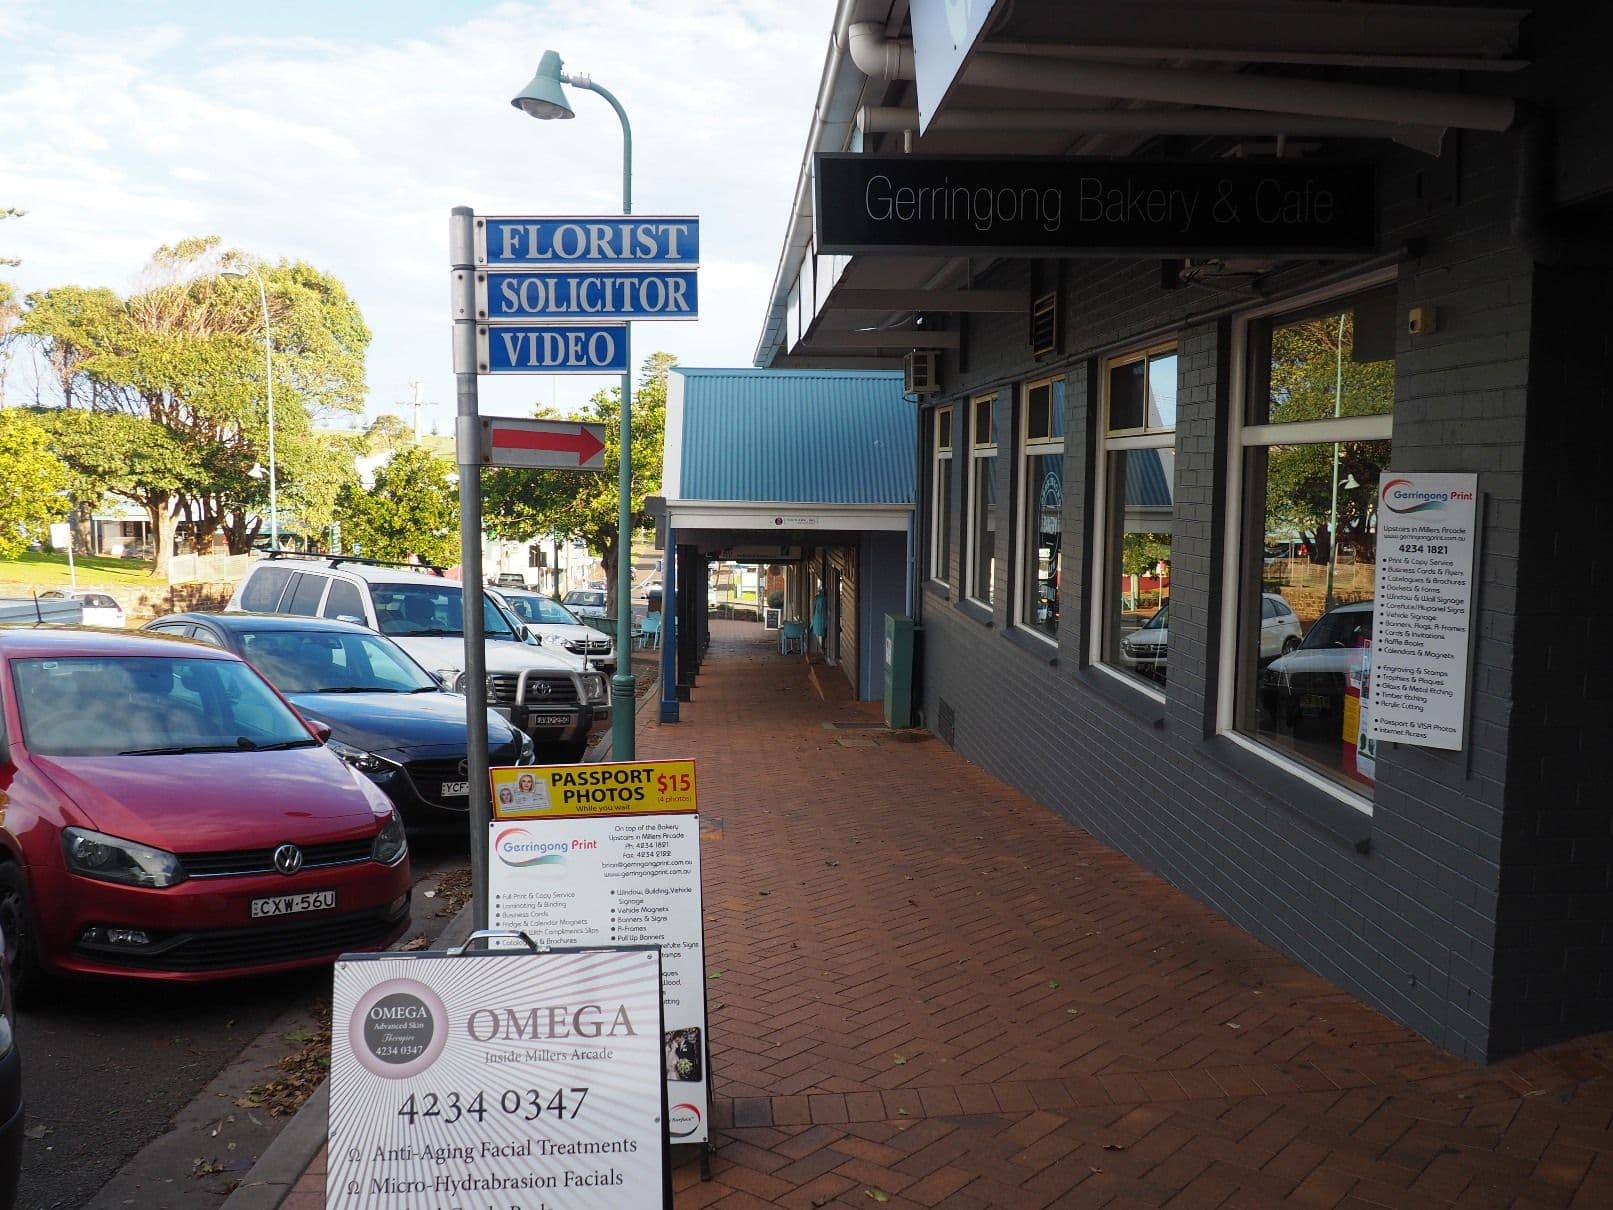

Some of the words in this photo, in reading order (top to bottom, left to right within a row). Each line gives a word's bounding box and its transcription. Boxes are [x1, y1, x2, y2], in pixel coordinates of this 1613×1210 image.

[865, 175, 1062, 231] Gerringong
[1080, 177, 1199, 232] Bakery
[1212, 178, 1240, 223] &
[1255, 178, 1335, 224] Cafe
[499, 224, 688, 259] FLORIST
[501, 277, 690, 313] SOLICITOR
[501, 331, 615, 367] VIDEO
[1394, 491, 1447, 501] Gerringong
[1451, 492, 1472, 500] Print
[1399, 545, 1423, 553] 4234
[1428, 546, 1448, 554] 1821
[1388, 576, 1423, 584] Catalogues
[1437, 596, 1464, 605] Signage
[1410, 613, 1436, 621] Signage
[1384, 647, 1415, 655] Calendars
[1425, 650, 1454, 659] Magnets
[1383, 665, 1414, 675] Engraving
[1404, 694, 1427, 703] Etching
[1430, 688, 1453, 697] Etching
[1402, 703, 1424, 712] Cutting
[1380, 718, 1408, 727] Passport
[1380, 726, 1403, 735] Internet
[552, 769, 654, 786] PASSPORT
[657, 773, 691, 794] $15
[564, 787, 645, 803] PHOTOS
[666, 795, 691, 803] photos)
[504, 842, 568, 853] Gerringong
[572, 840, 597, 849] Print
[371, 1006, 428, 1019] OMEGA
[467, 1004, 638, 1042] OMEGA
[376, 1046, 398, 1055] 4234
[401, 1046, 423, 1054] 0347
[485, 1051, 521, 1064] Inside
[525, 1049, 567, 1062] Millers
[571, 1048, 614, 1060] Arcade
[398, 1090, 487, 1124] 4234
[501, 1087, 589, 1120] 0347
[373, 1144, 475, 1164] Anti-Aging
[481, 1140, 531, 1158] Facial
[536, 1138, 637, 1156] Treatments
[370, 1173, 557, 1196] Micro-Hydrabrasion
[564, 1168, 624, 1187] Facials
